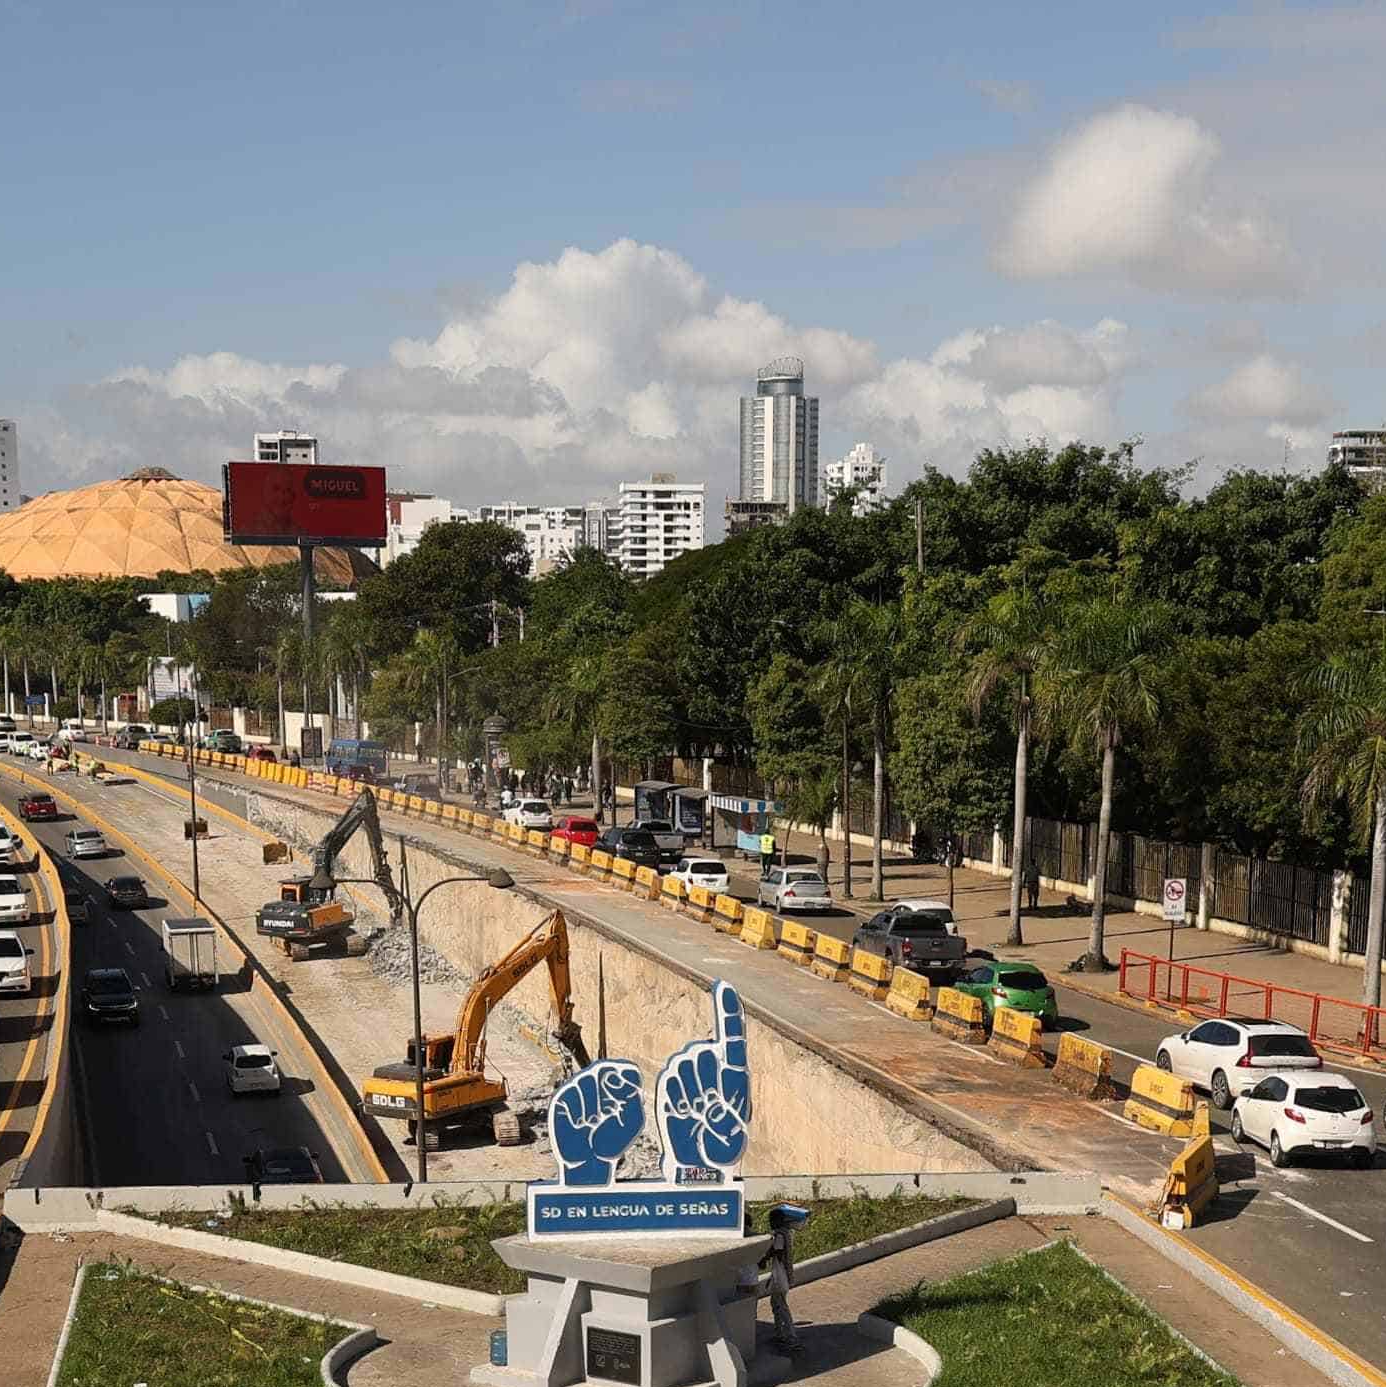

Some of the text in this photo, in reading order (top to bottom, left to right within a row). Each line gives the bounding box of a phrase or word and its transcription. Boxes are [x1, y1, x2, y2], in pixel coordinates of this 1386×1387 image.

[263, 919, 295, 928] HYUNDAI
[372, 1094, 406, 1108] SDLG
[541, 1201, 729, 1219] SD EN LENGUA DE SEÑAS
